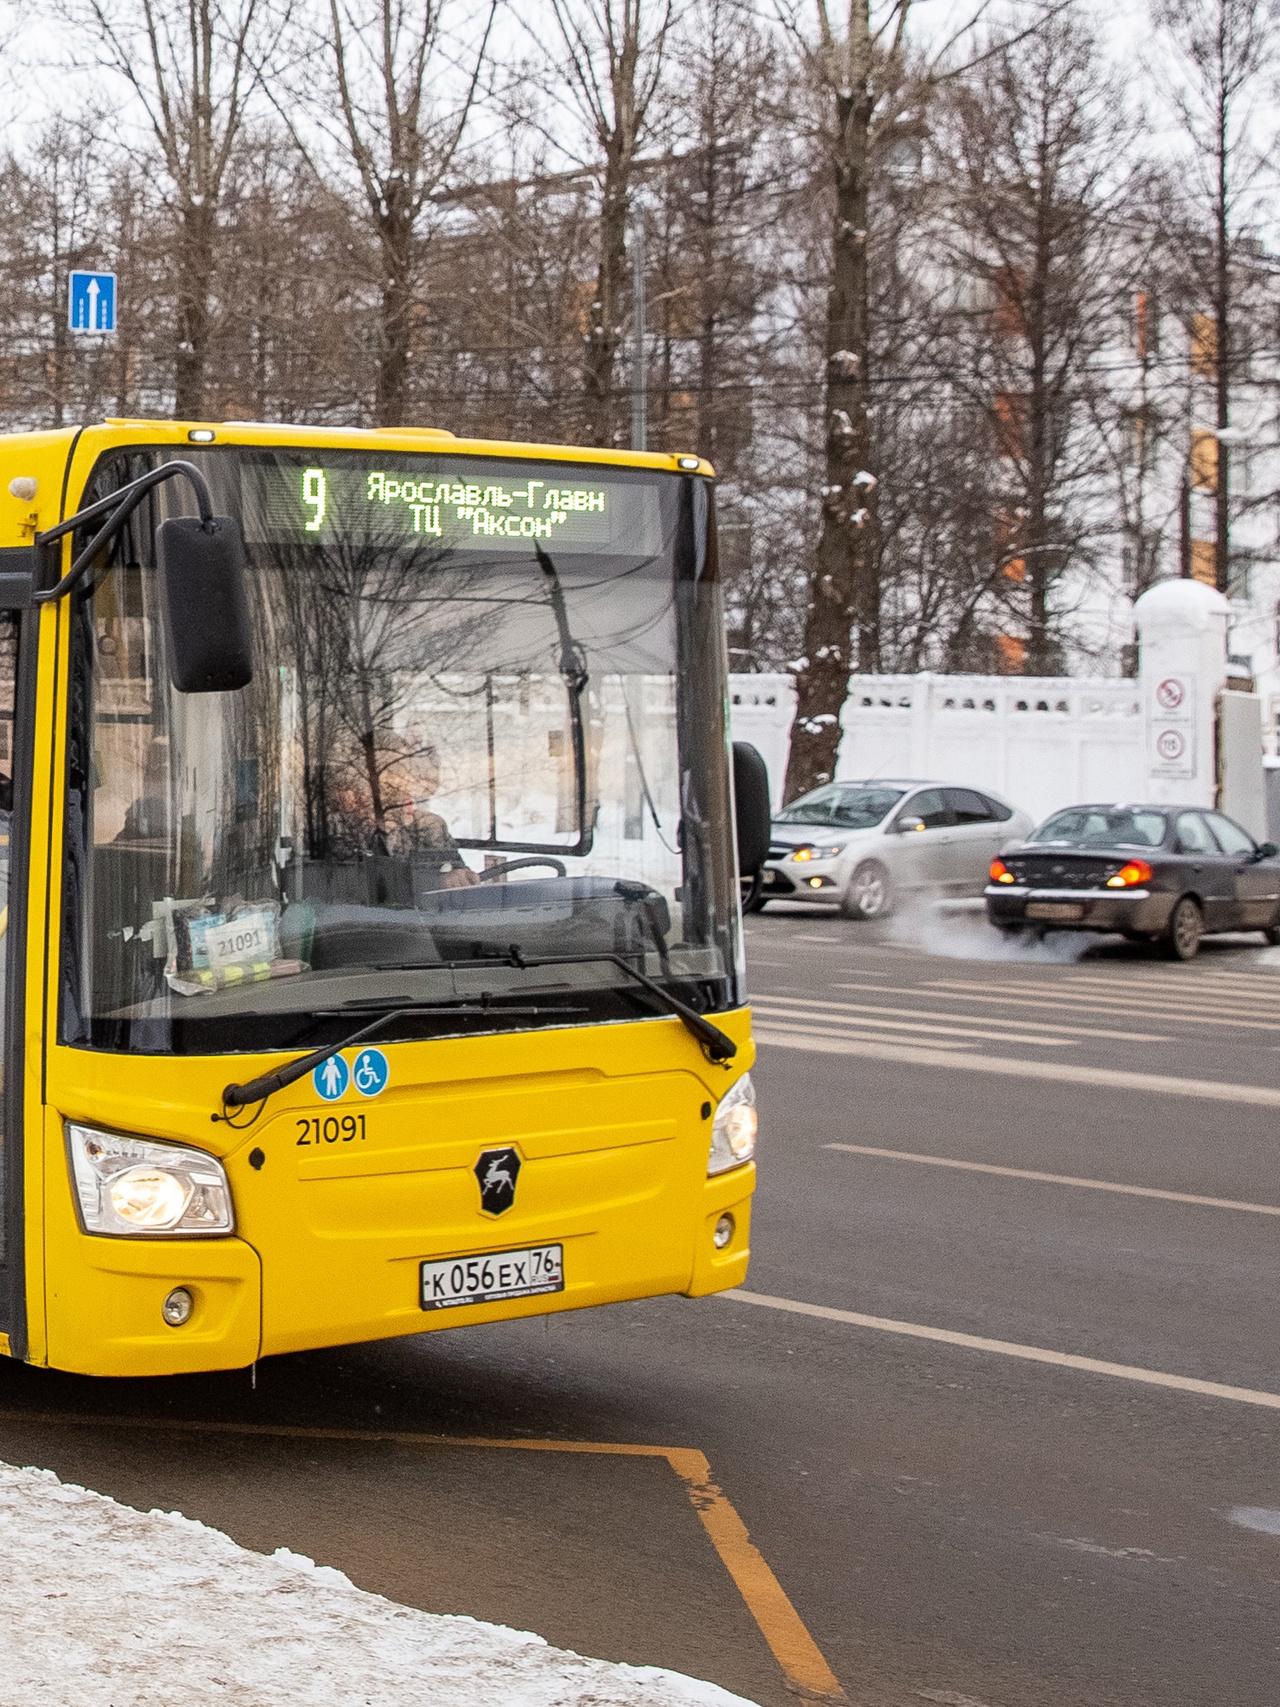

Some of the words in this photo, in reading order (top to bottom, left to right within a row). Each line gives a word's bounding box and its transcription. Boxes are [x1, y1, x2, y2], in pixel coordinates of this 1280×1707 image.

[302, 468, 326, 531] 9
[367, 472, 606, 512] Ярославль-Главн
[409, 503, 442, 536] ТЦ
[218, 929, 261, 957] 21091
[296, 1114, 368, 1146] 21091
[533, 1250, 554, 1275] 76
